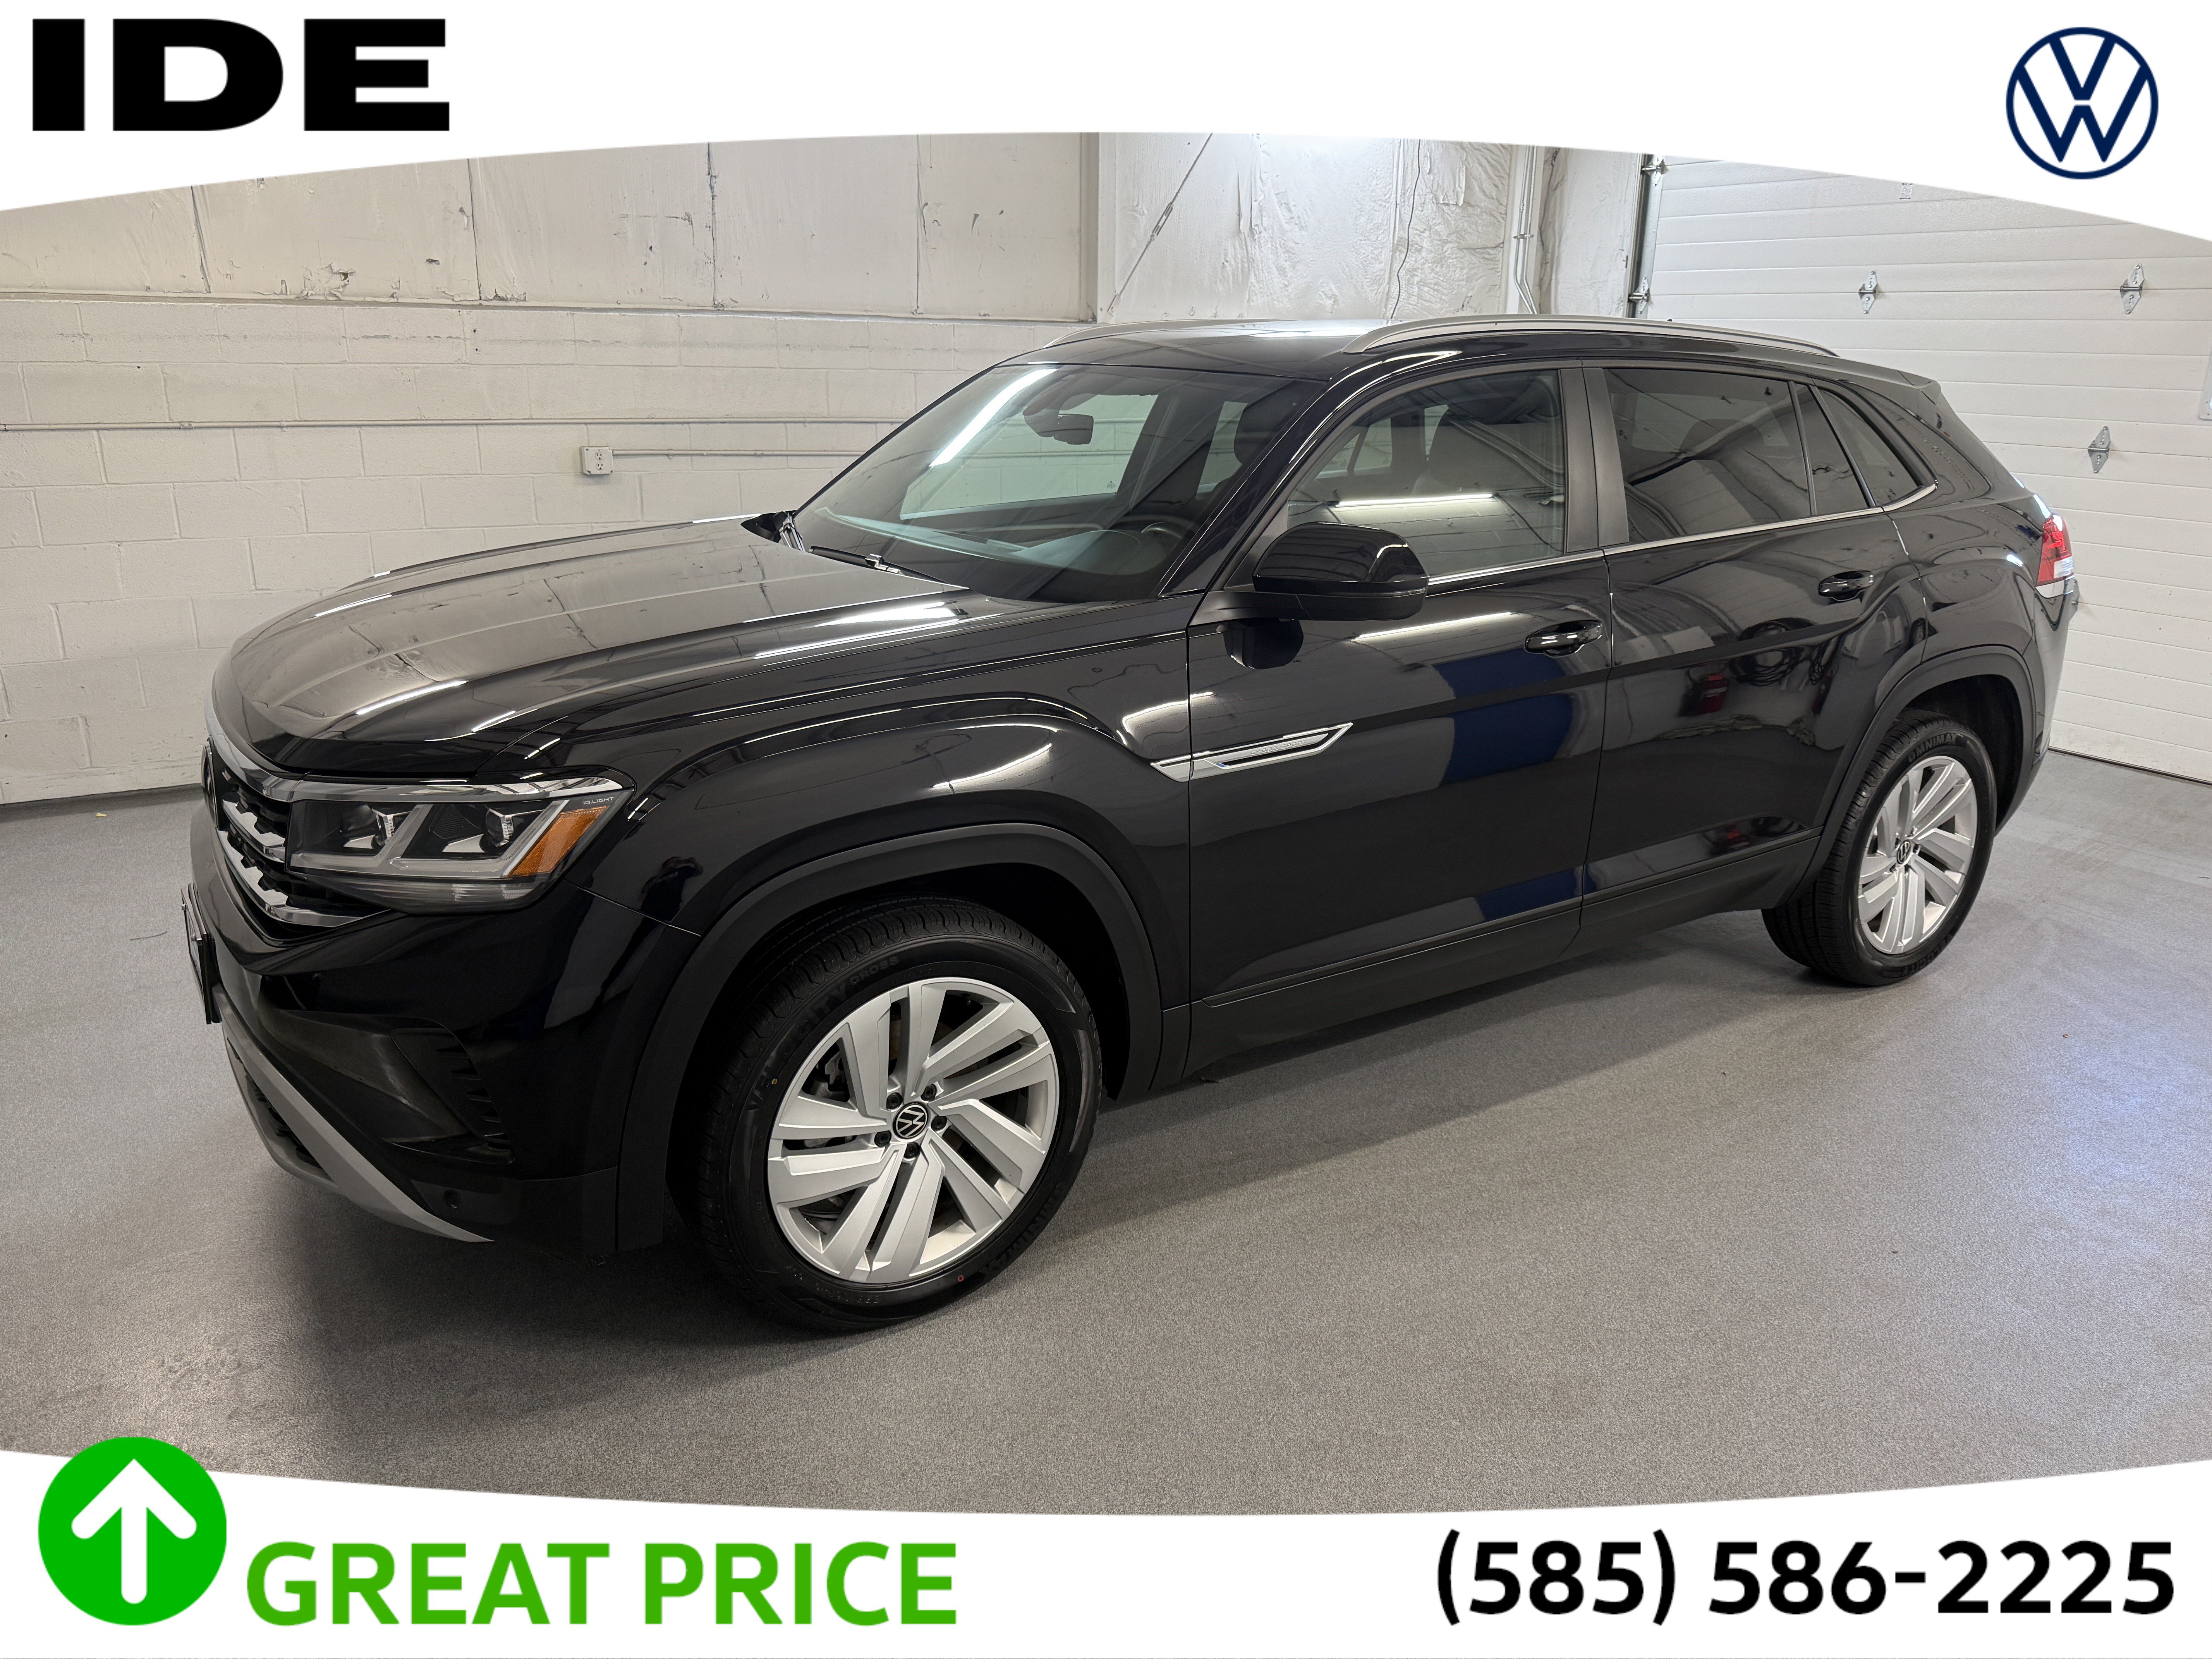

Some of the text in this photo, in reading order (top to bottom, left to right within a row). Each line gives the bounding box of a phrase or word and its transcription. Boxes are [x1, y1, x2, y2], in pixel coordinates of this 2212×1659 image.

[1251, 740, 1307, 755] CROSS SPORT
[1908, 733, 1957, 763] OMNIMAX
[850, 956, 899, 985] CROSS
